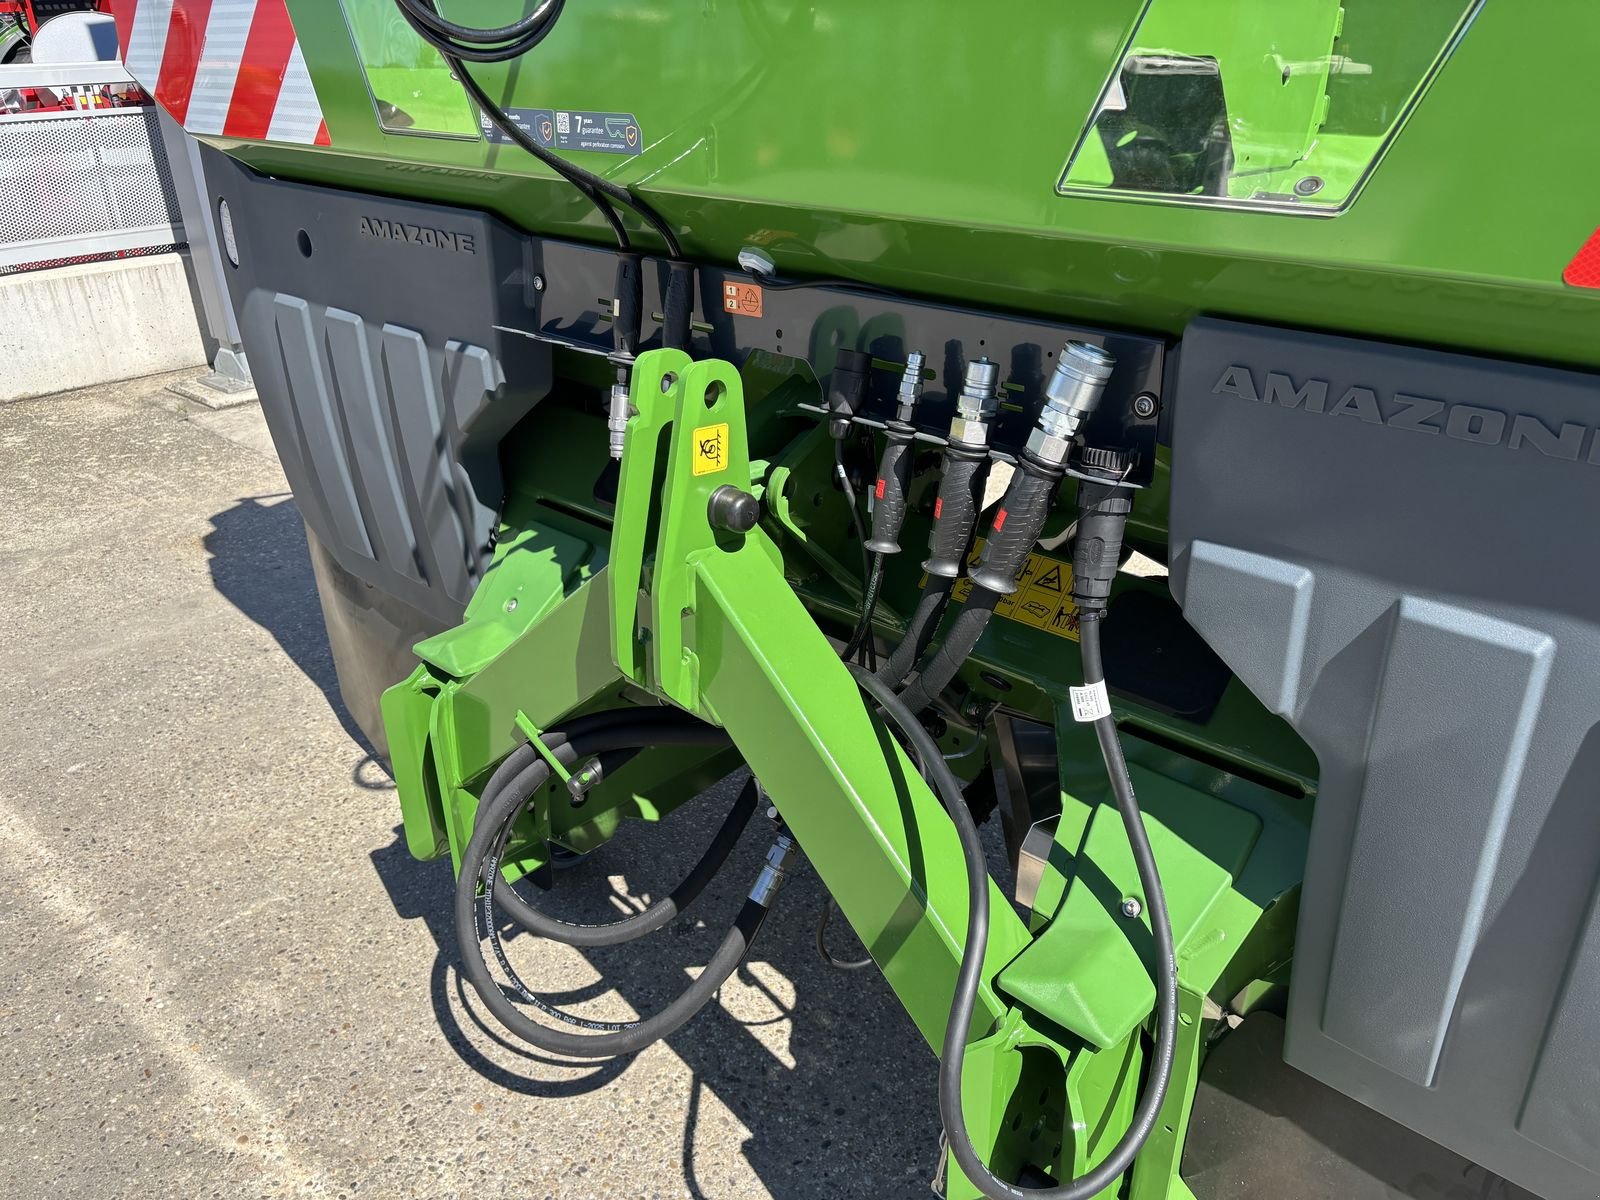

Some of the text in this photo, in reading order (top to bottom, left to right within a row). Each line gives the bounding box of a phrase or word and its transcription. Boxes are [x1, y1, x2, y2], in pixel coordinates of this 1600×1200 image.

[575, 116, 582, 133] 7
[582, 127, 604, 135] guarantee
[359, 215, 476, 255] AMAZONE
[729, 287, 734, 295] 1
[729, 300, 735, 308] 2
[1211, 364, 1600, 466] AMAZON
